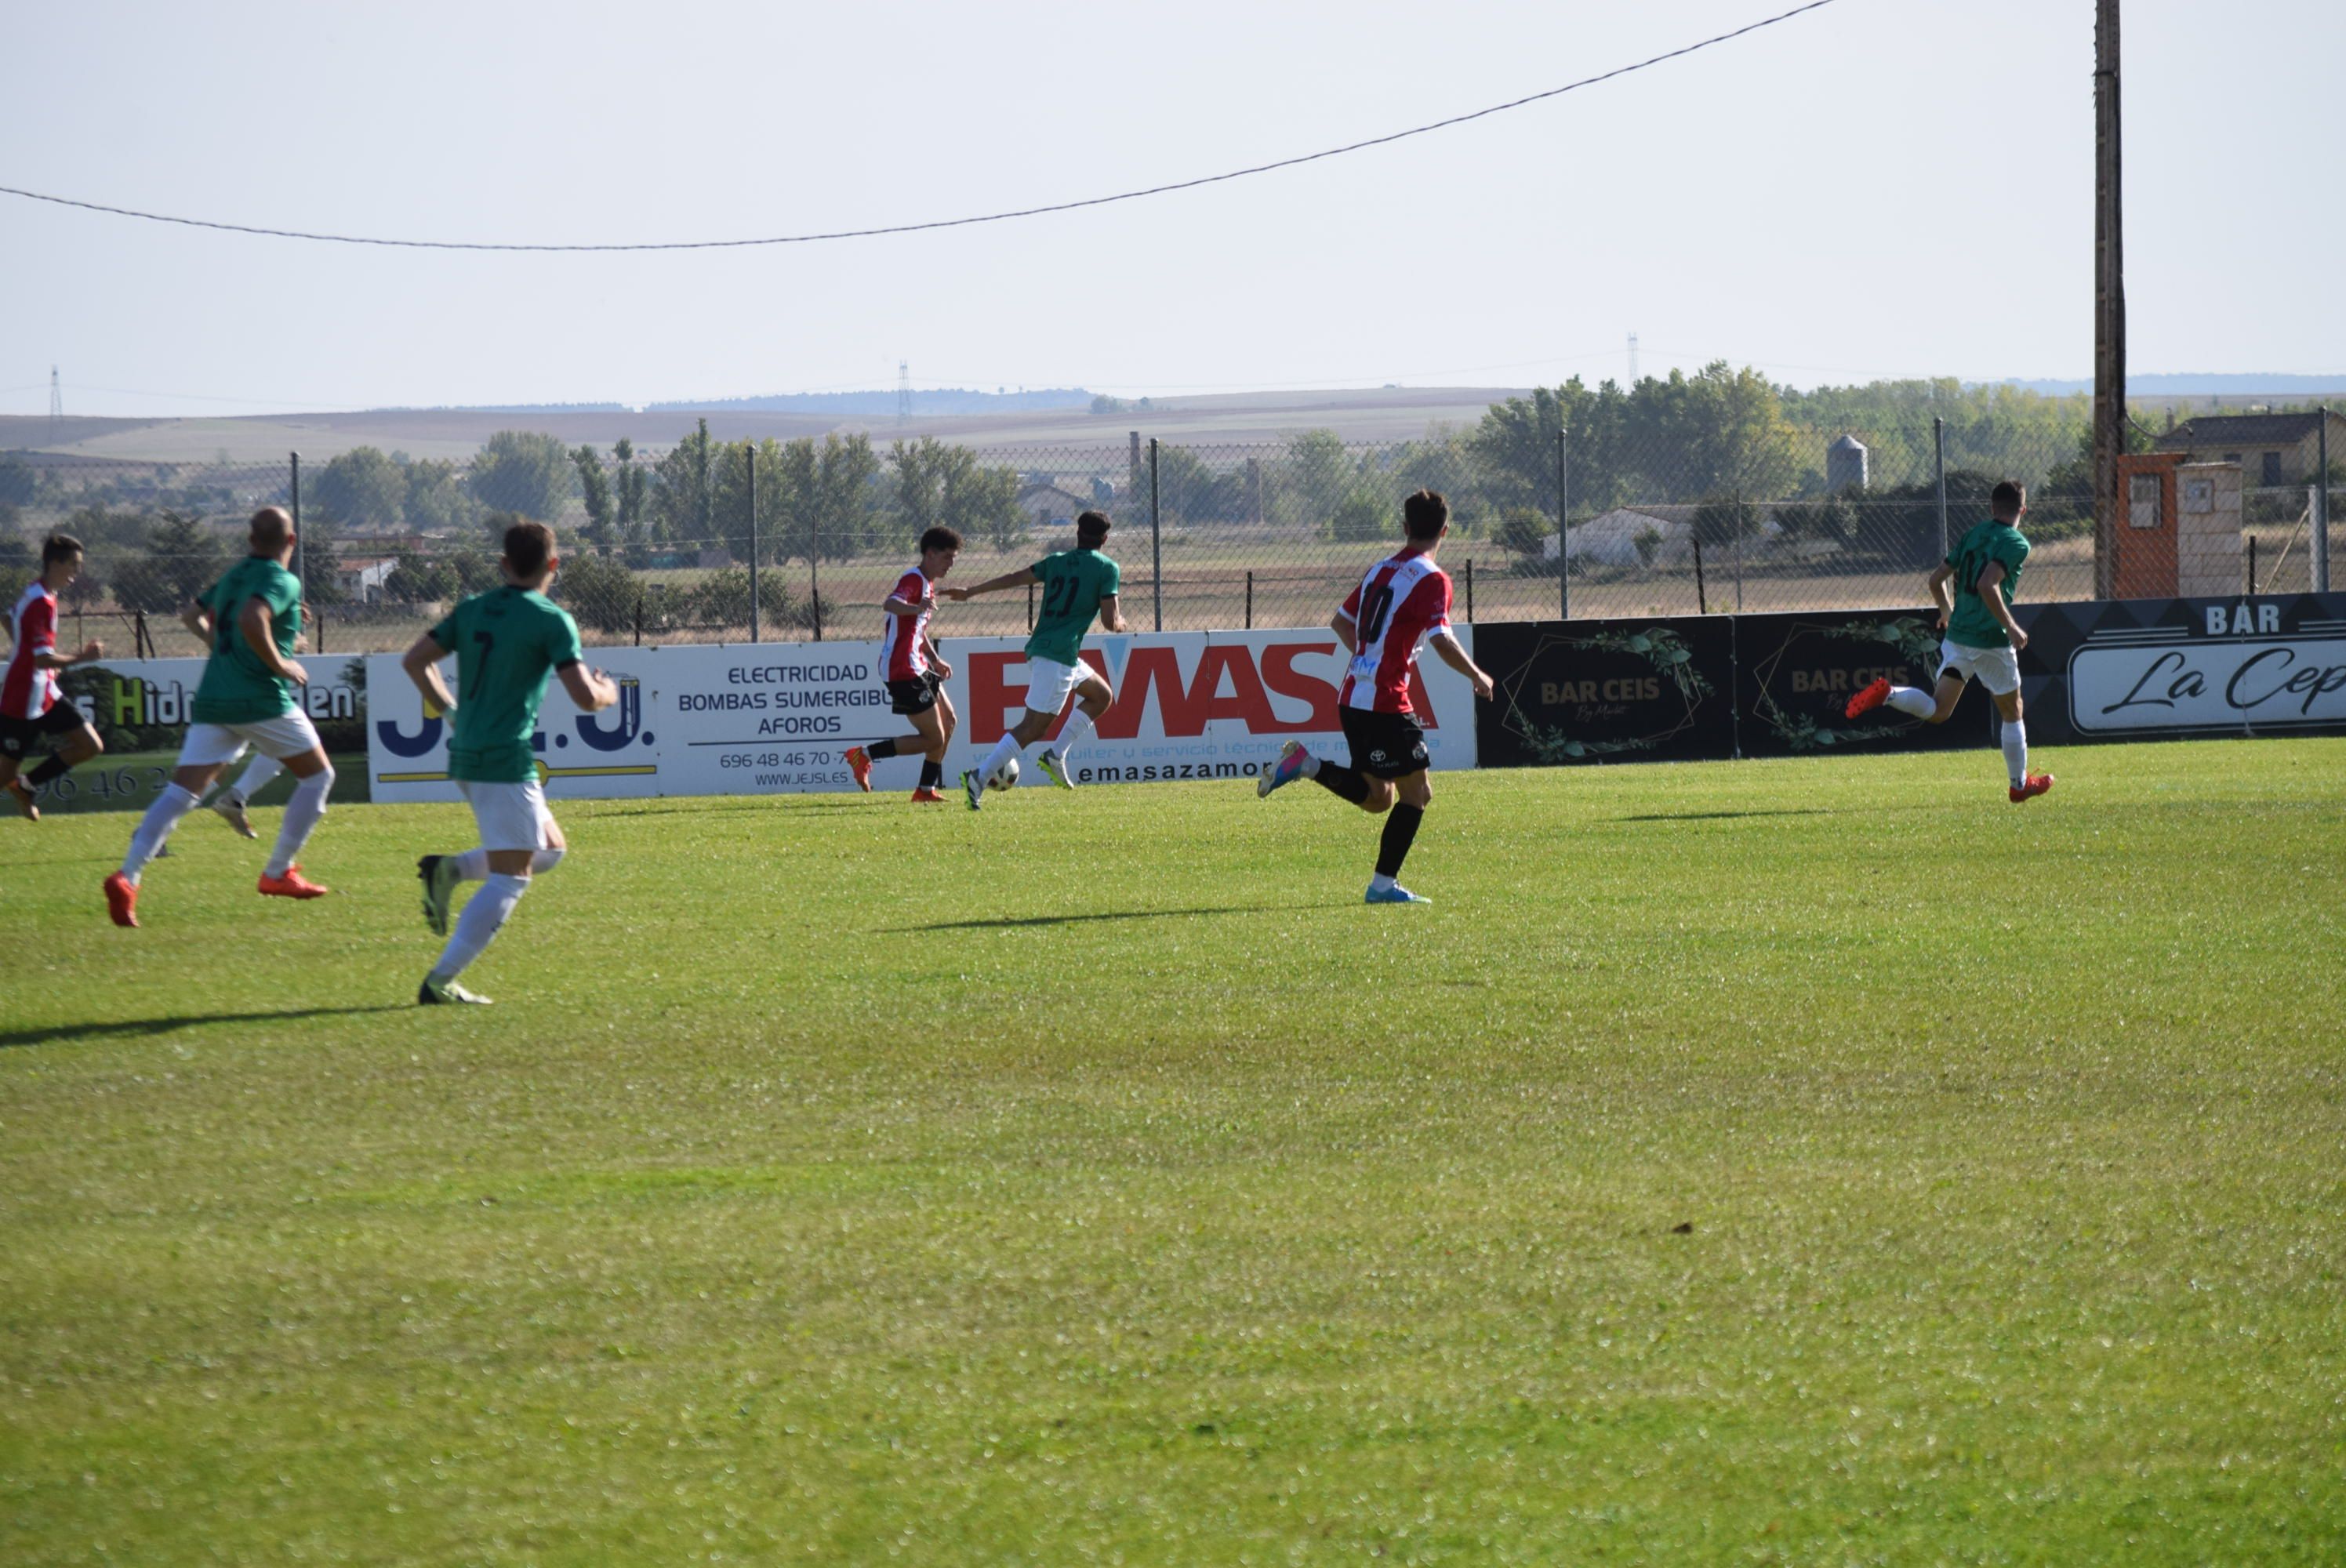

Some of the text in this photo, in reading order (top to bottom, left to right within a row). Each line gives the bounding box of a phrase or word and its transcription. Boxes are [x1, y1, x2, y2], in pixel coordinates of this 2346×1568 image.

[1044, 575, 1080, 618] 21
[2206, 604, 2280, 635] BAR
[469, 631, 494, 700] 7
[728, 665, 868, 684] ELECTRICIDAD
[968, 642, 1440, 744] EMAS
[1541, 677, 1661, 705] BAR CEIS
[1792, 669, 1849, 693] BAR
[2101, 652, 2207, 714] La
[679, 689, 892, 711] BOMBAS SUMERGIBL
[758, 716, 841, 734] AFOROS
[720, 753, 753, 768] 696
[757, 753, 779, 768] 48
[783, 752, 805, 767] 46
[809, 751, 830, 765] 70
[1142, 743, 1218, 757] servicio
[1225, 741, 1284, 754] técnic
[89, 764, 139, 801] 46
[755, 771, 848, 786] WWW.JEJSL.ES
[1078, 761, 1274, 783] emasazamor
